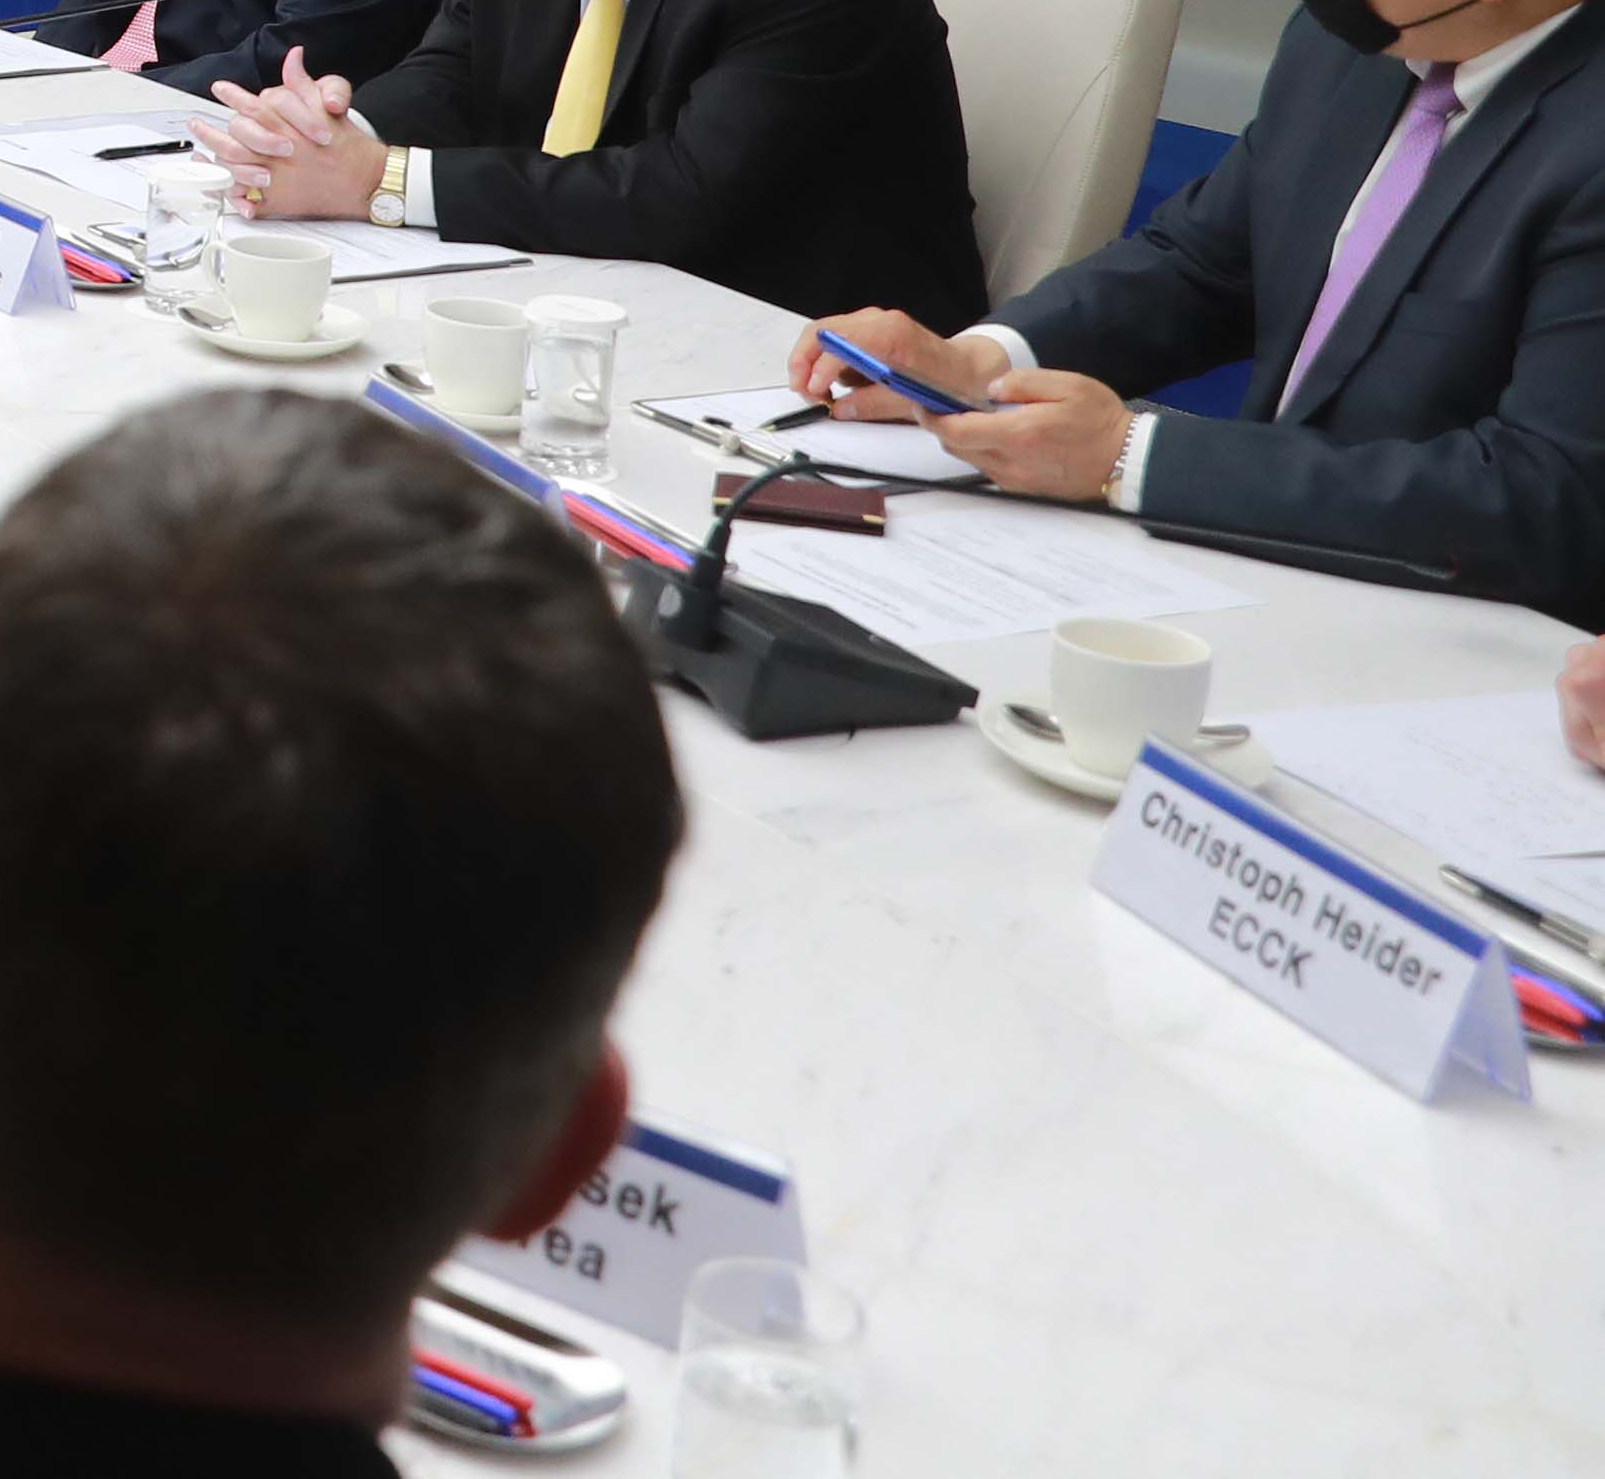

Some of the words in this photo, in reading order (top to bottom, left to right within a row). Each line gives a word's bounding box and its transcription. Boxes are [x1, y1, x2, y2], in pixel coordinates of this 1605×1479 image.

[1140, 790, 1307, 917] Christoph
[1312, 894, 1444, 998] Heider
[1208, 896, 1315, 991] ECCK
[577, 1170, 682, 1237] sek
